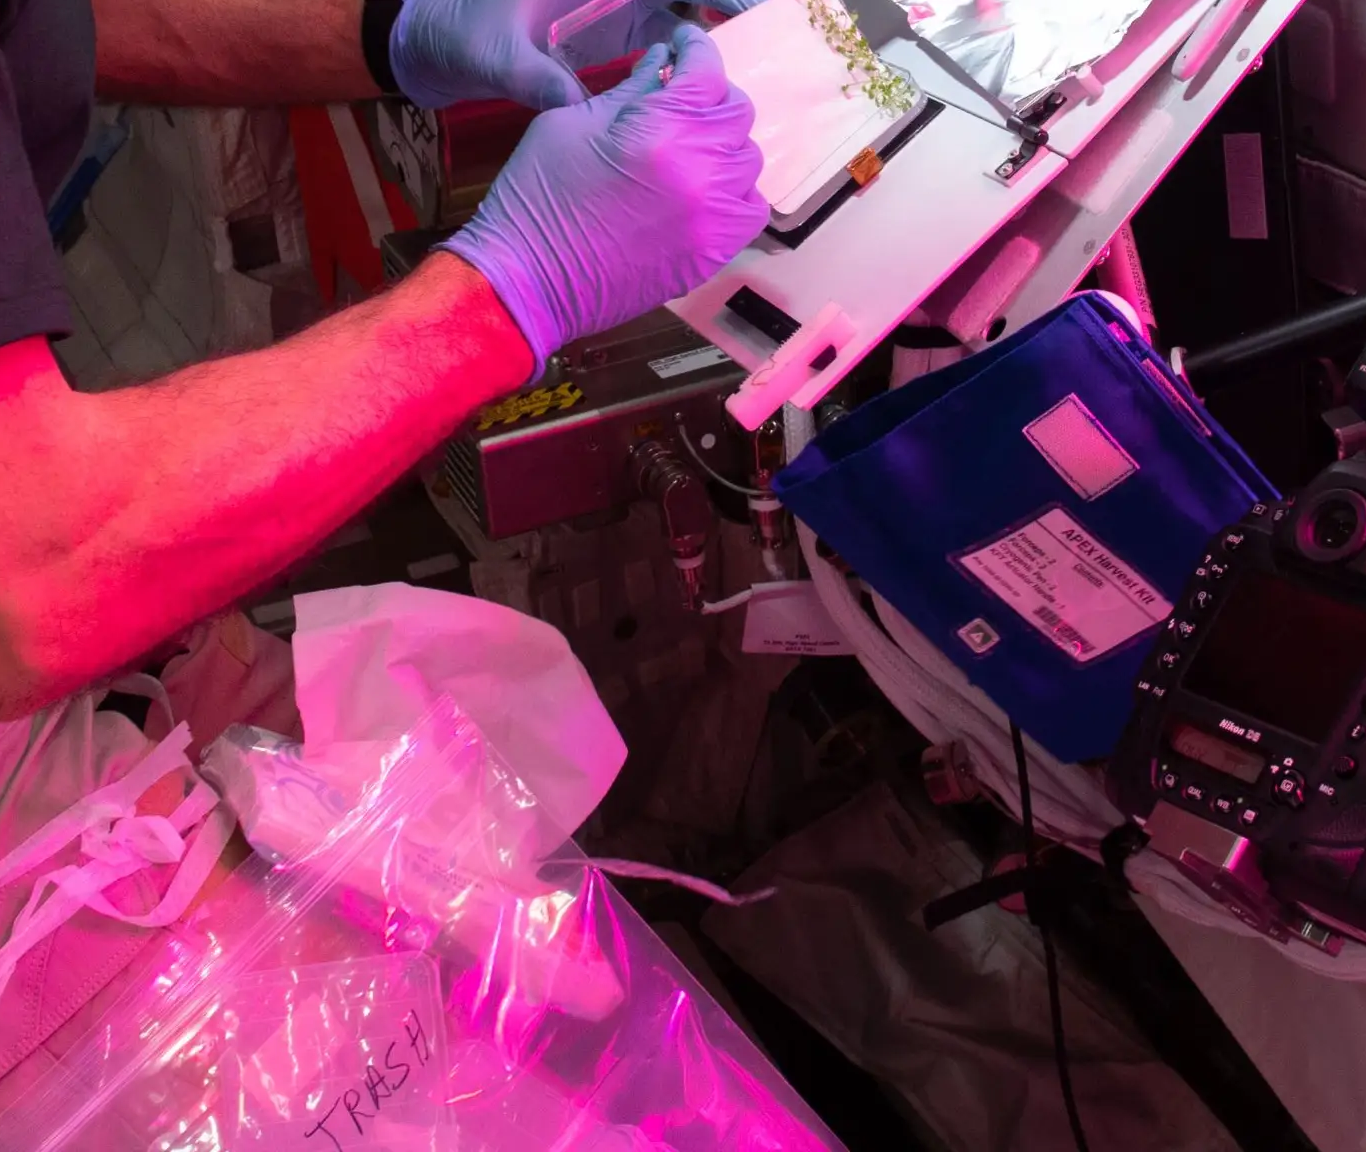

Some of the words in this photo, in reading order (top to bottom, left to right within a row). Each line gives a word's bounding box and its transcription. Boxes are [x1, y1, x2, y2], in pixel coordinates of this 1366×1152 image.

[1017, 532, 1046, 557] Forceps
[1061, 528, 1098, 557] APEX
[1093, 552, 1140, 591] Harvest
[1134, 584, 1157, 606] Kit
[1163, 652, 1175, 664] OK
[1218, 718, 1246, 736] Nikon
[1318, 782, 1336, 797] MIC
[303, 1008, 430, 1152] TRASH
